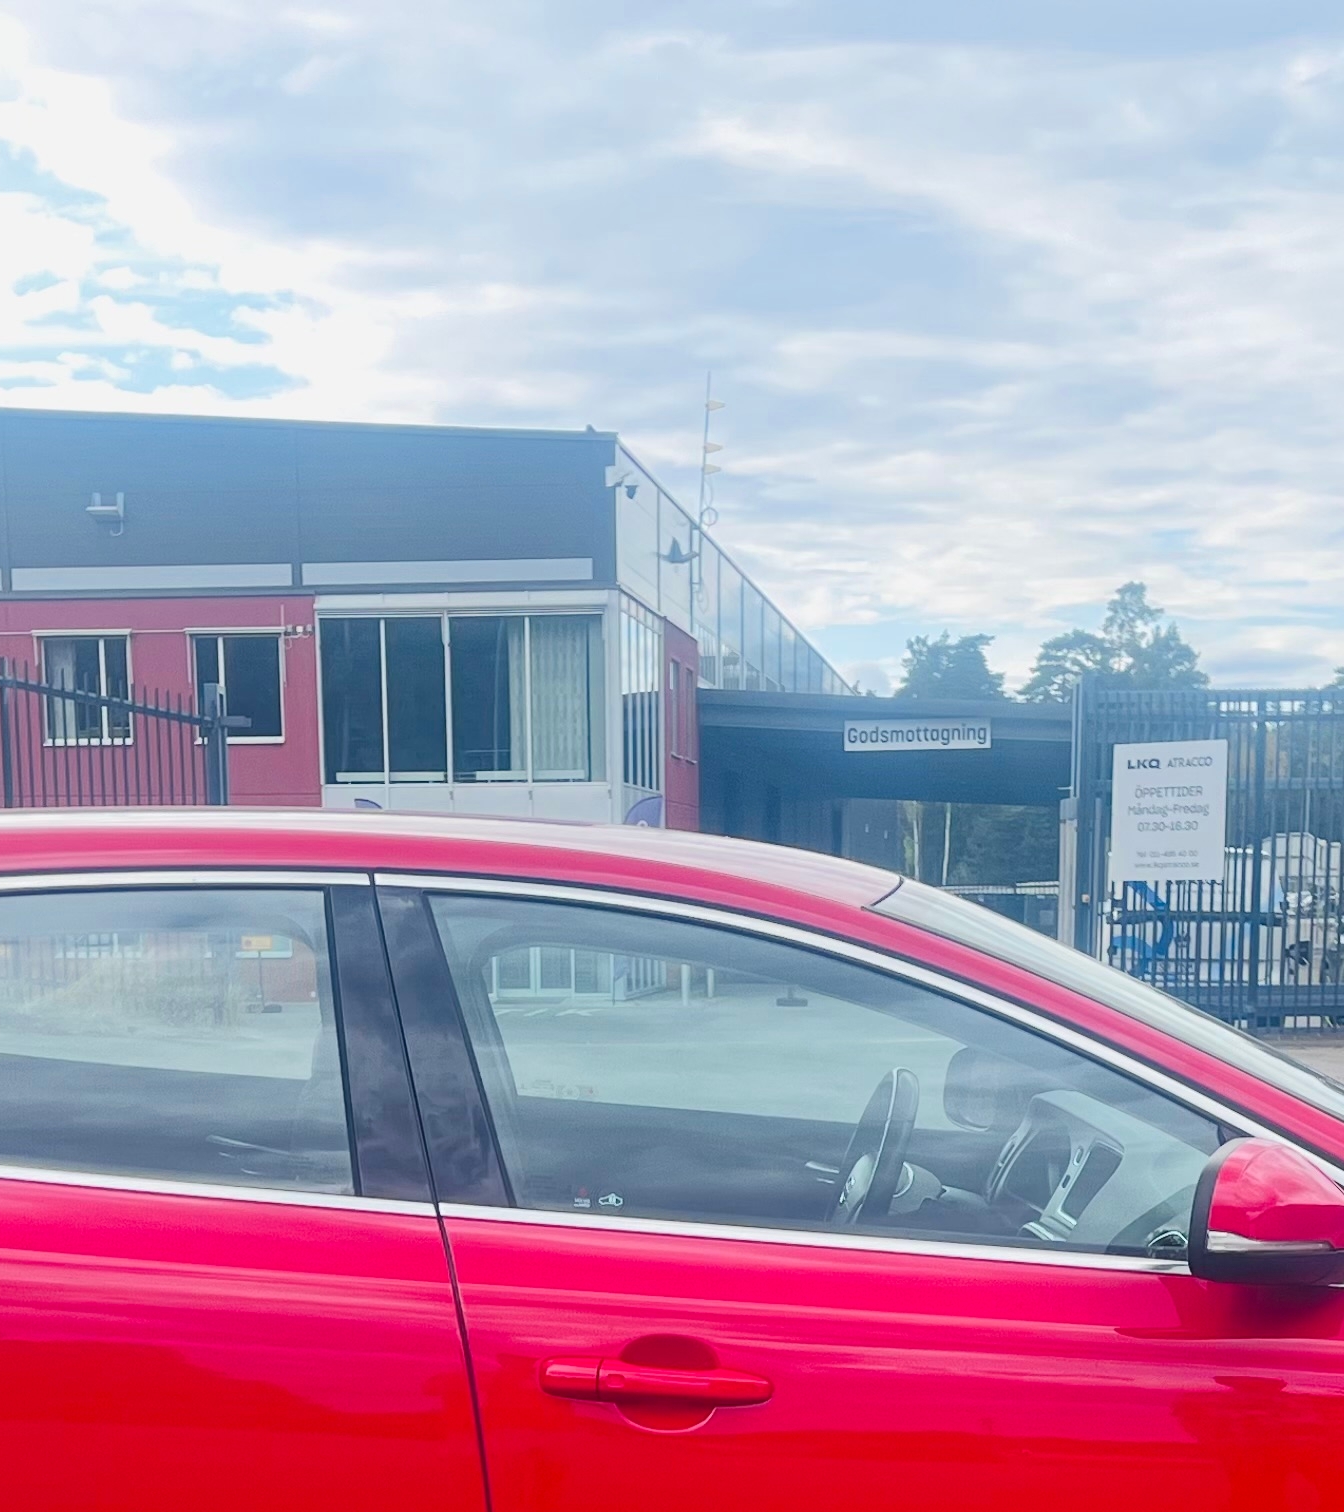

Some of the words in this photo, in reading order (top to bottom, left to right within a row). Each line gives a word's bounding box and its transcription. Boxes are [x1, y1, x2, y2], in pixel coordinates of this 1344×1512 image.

[847, 723, 987, 745] Godsmottagning
[1127, 758, 1162, 770] LKQ
[1167, 756, 1213, 768] ATRACCO
[1134, 785, 1203, 799] ÖPPETTIDER
